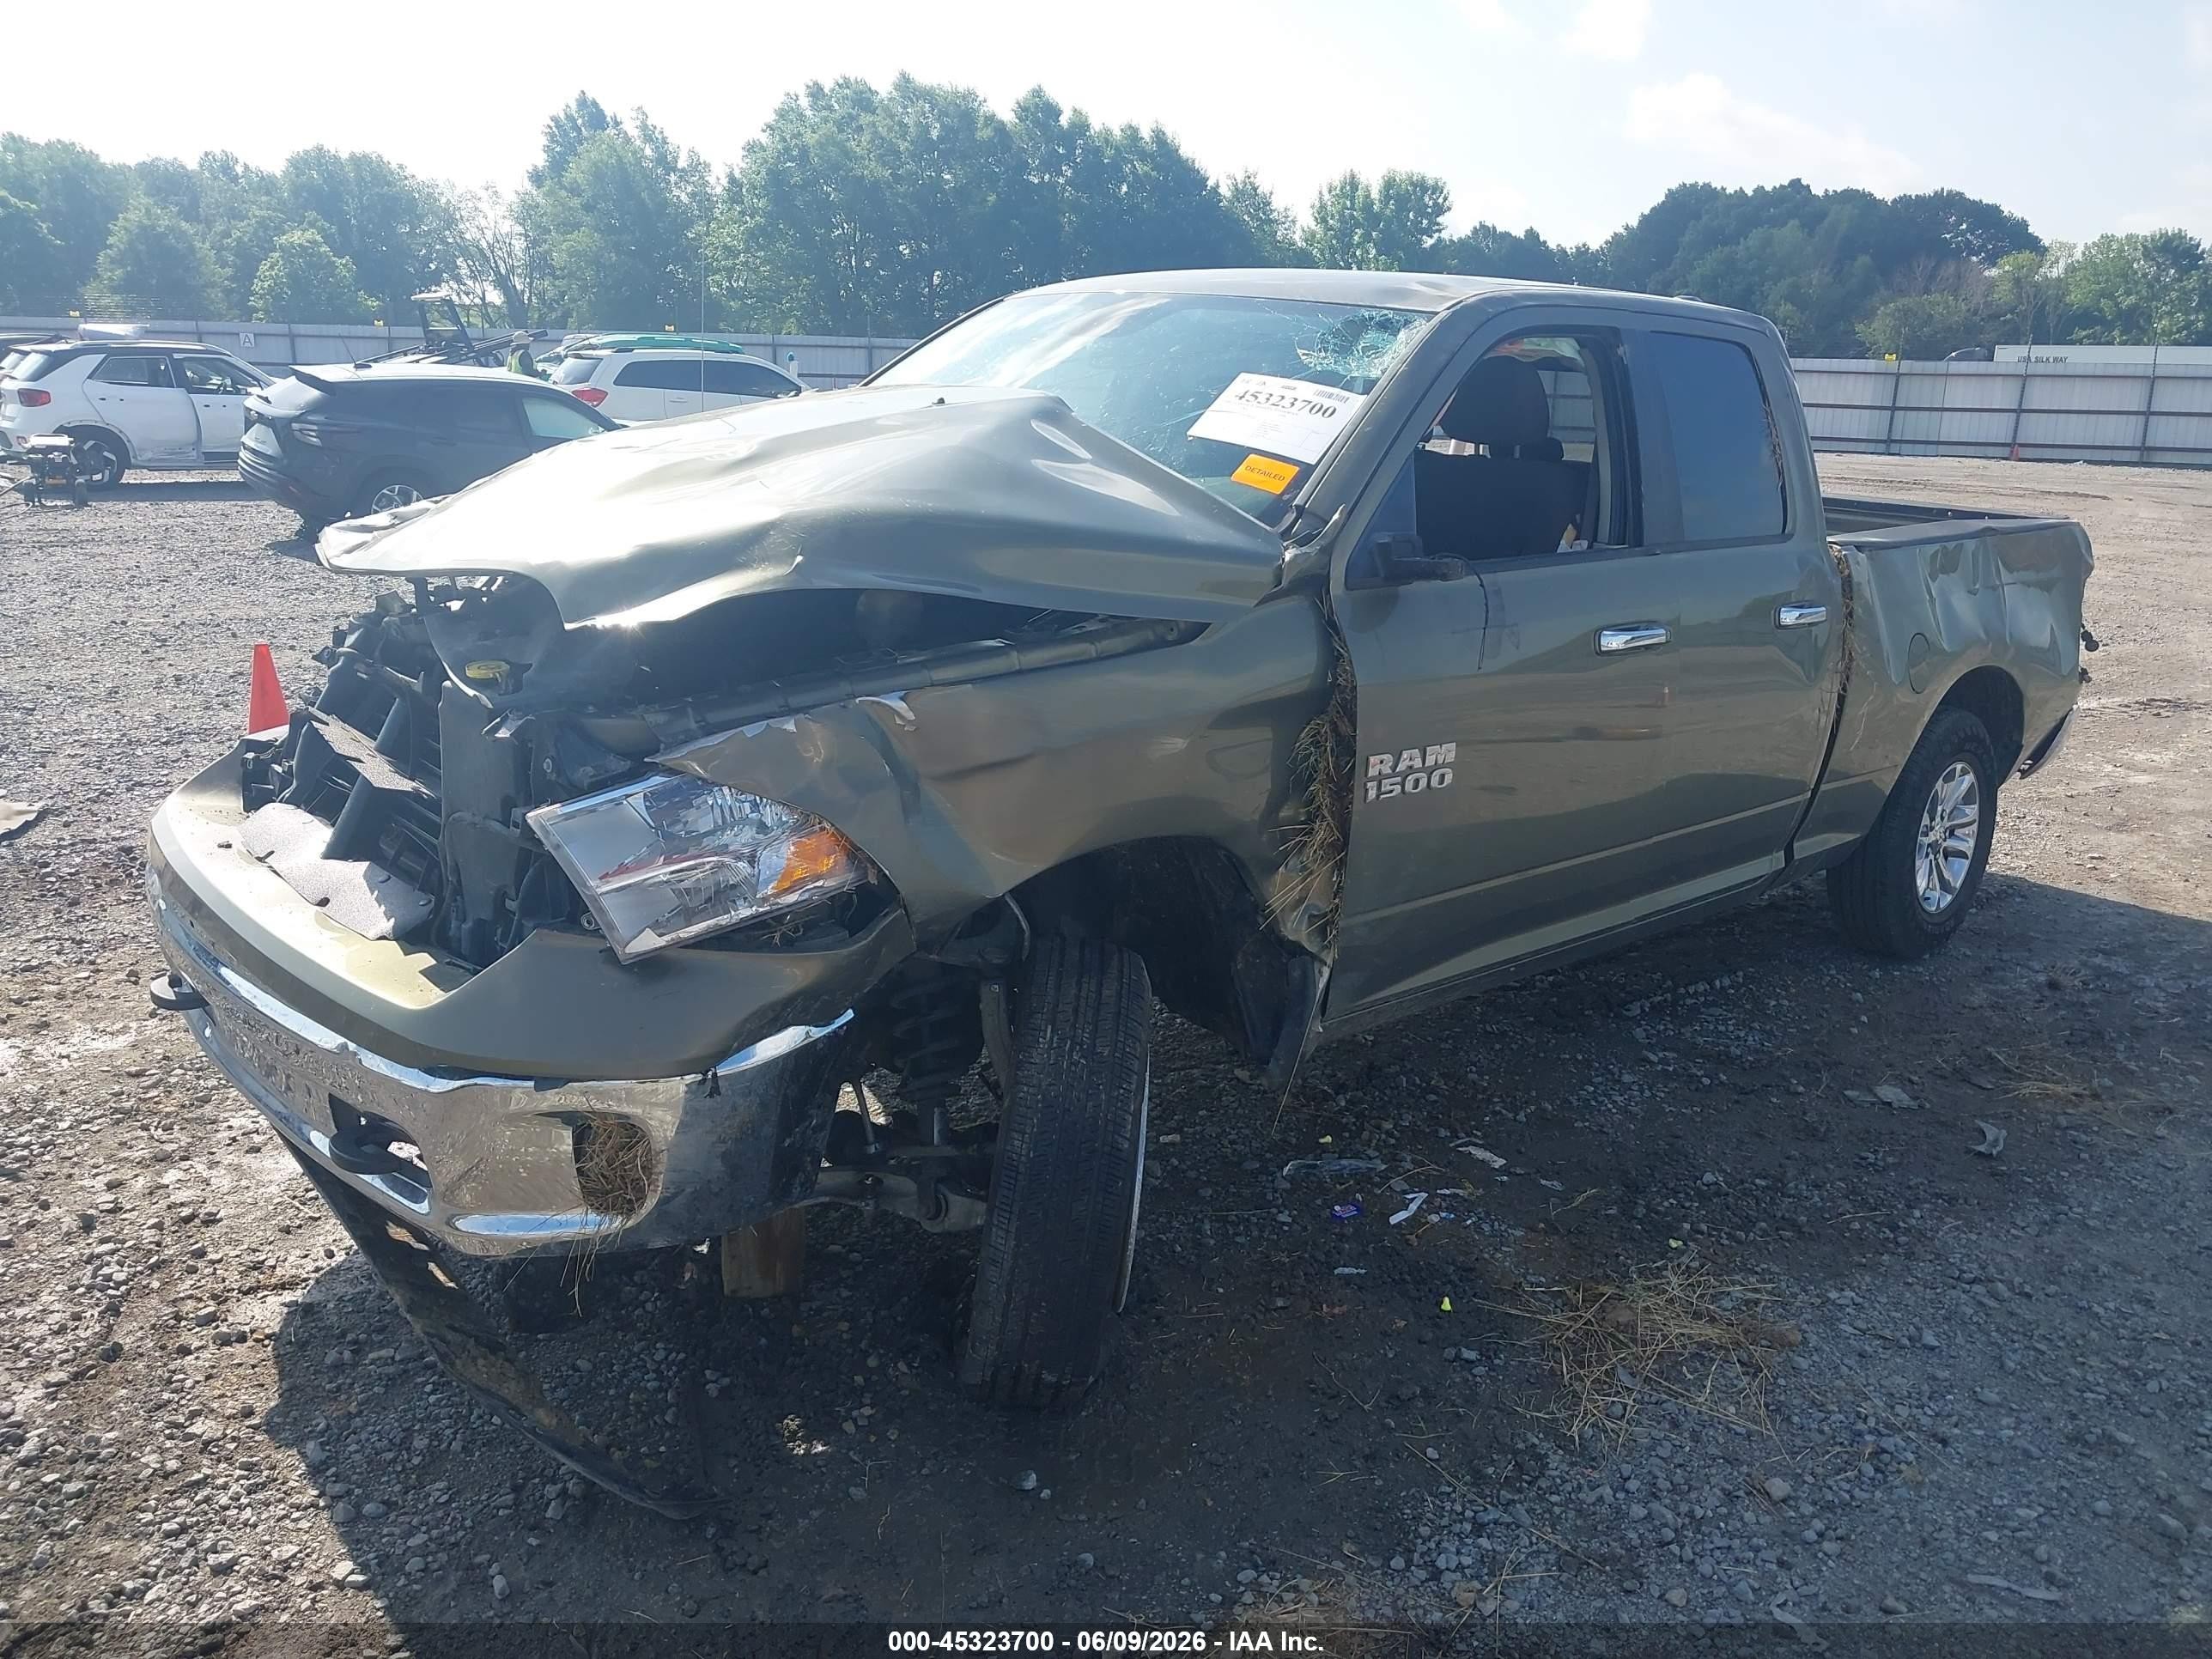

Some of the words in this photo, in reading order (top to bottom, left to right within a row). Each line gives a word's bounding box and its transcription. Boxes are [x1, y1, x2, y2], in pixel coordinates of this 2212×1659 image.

[242, 334, 253, 346] A
[2034, 356, 2051, 364] SILK
[2052, 356, 2069, 364] WAY
[1235, 389, 1337, 419] 45323700
[1244, 465, 1286, 483] DETAILED
[1366, 741, 1457, 778] RAM
[1364, 767, 1454, 804] 1500
